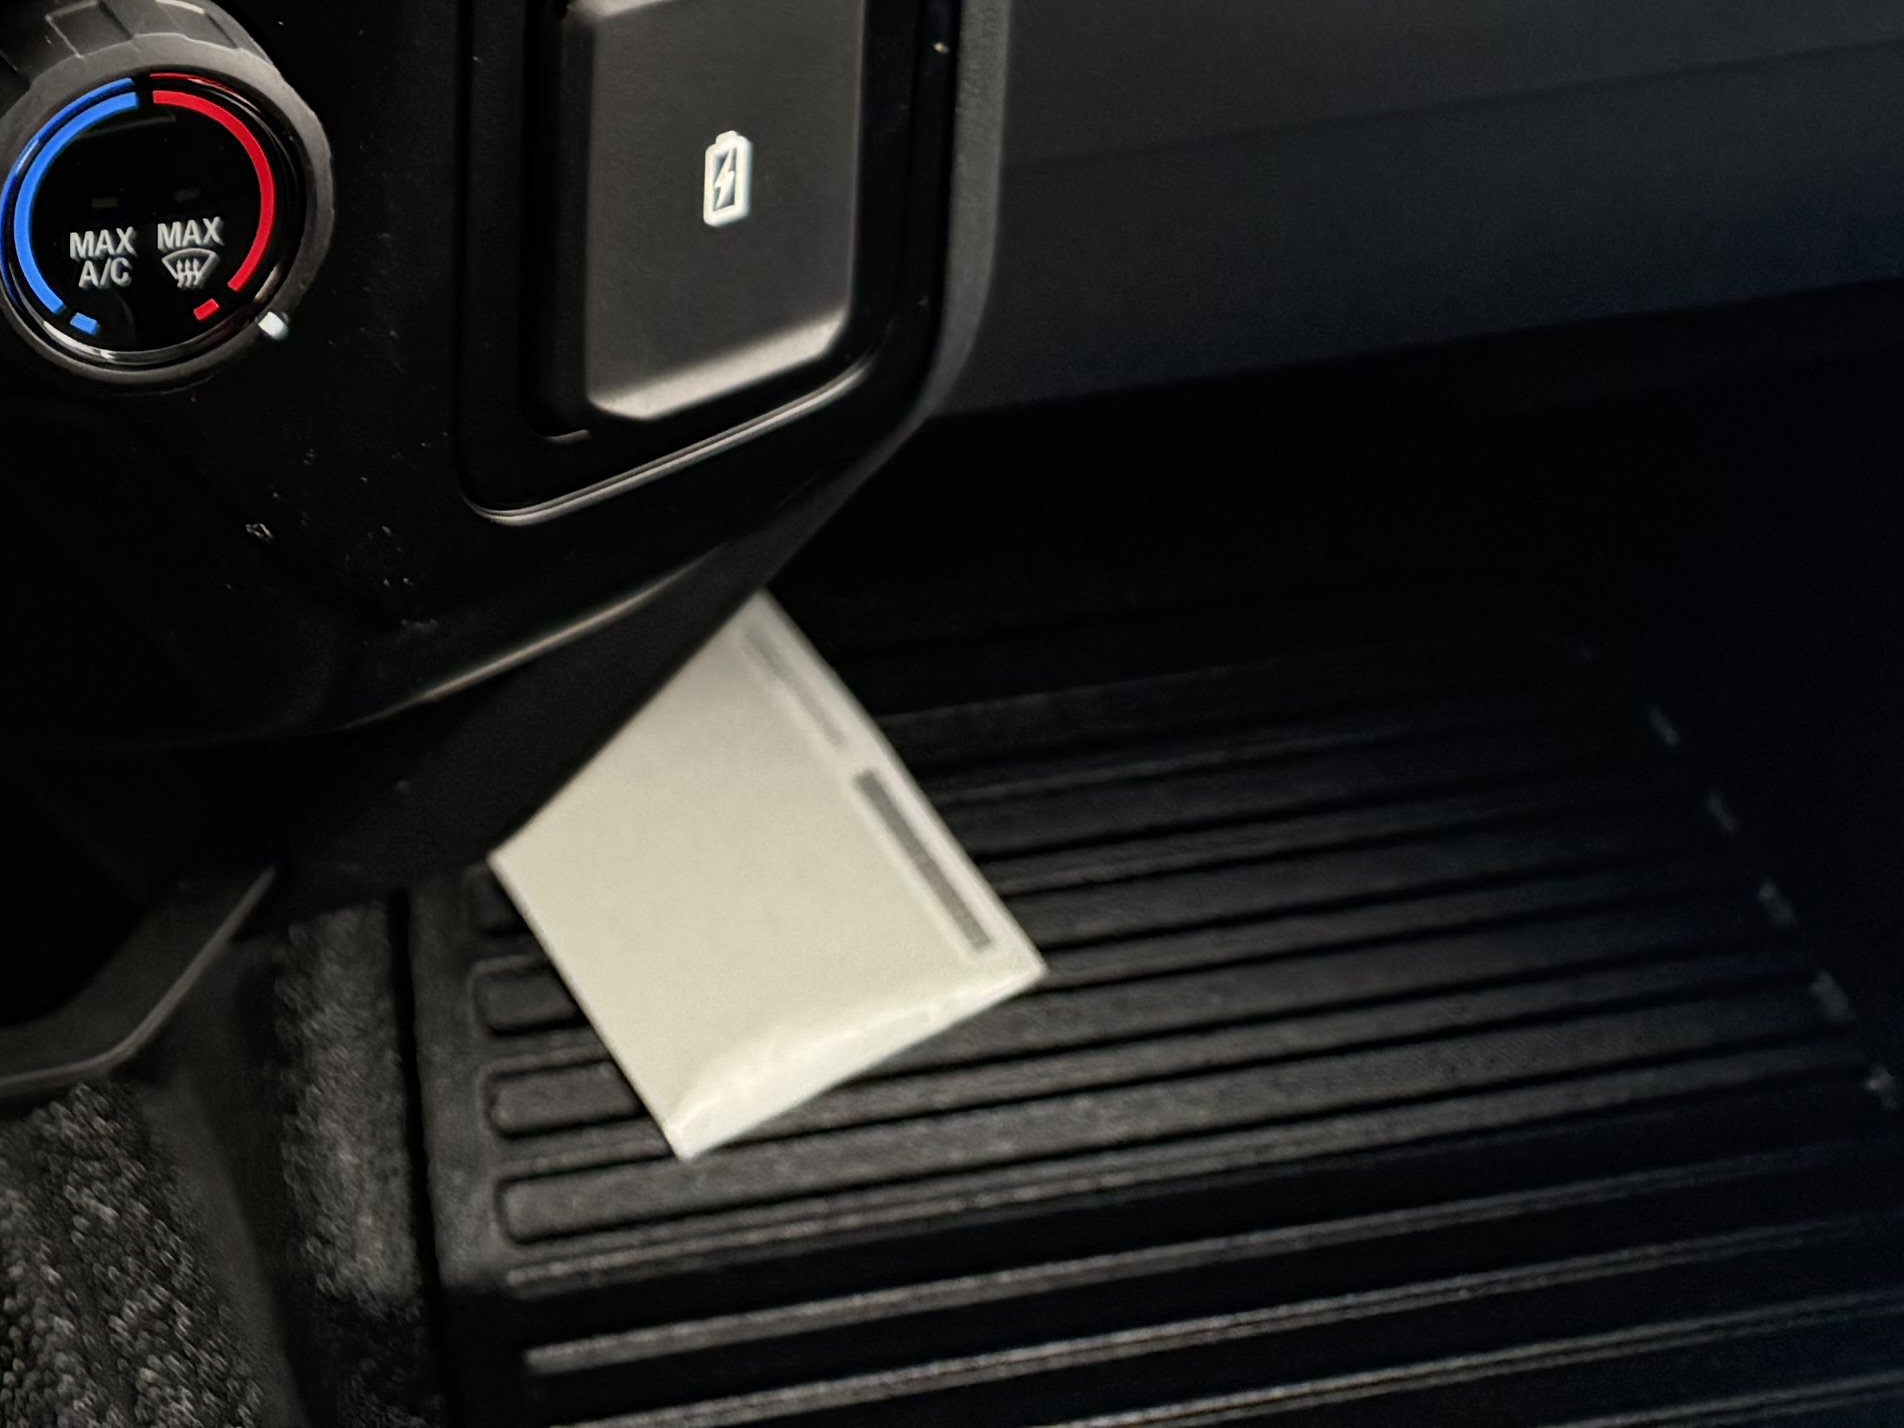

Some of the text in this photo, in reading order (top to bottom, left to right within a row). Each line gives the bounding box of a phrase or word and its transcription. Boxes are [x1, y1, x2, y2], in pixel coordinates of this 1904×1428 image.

[69, 226, 138, 261] MAX
[156, 216, 226, 251] MAX
[78, 256, 133, 290] A/C
